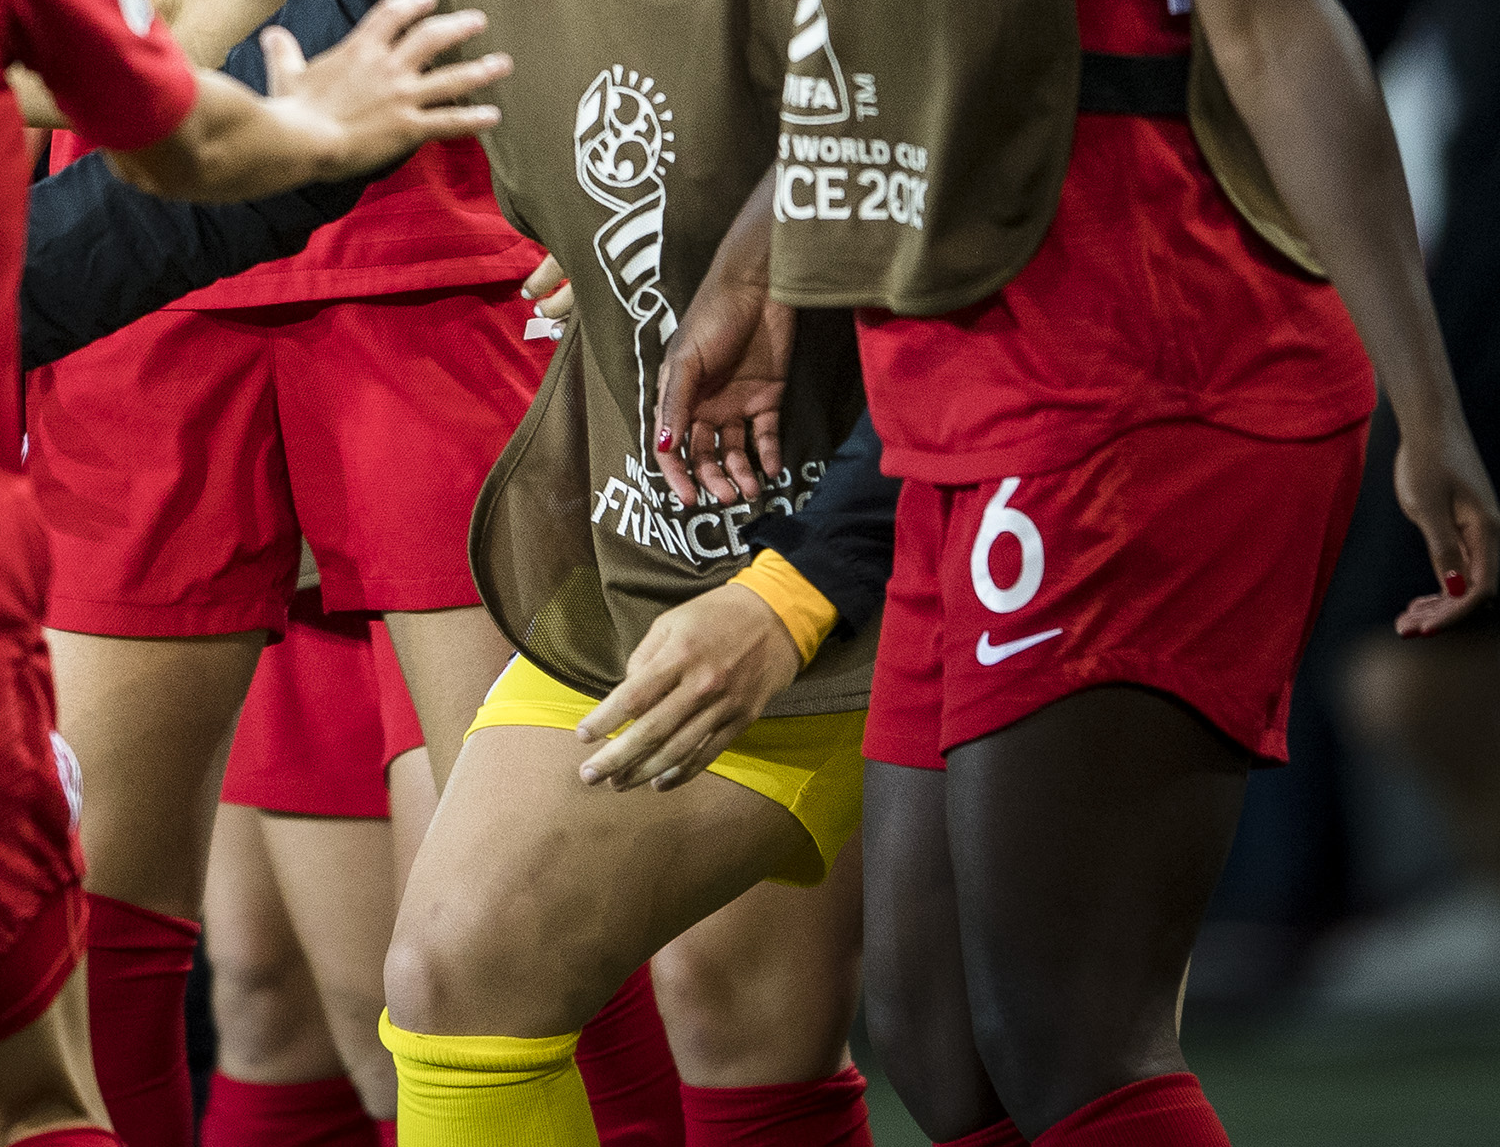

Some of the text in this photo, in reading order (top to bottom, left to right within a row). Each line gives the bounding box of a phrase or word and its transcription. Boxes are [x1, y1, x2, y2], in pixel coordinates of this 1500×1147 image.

[791, 133, 891, 165] WORLD
[590, 475, 752, 566] FRANCE
[970, 476, 1046, 615] 6
